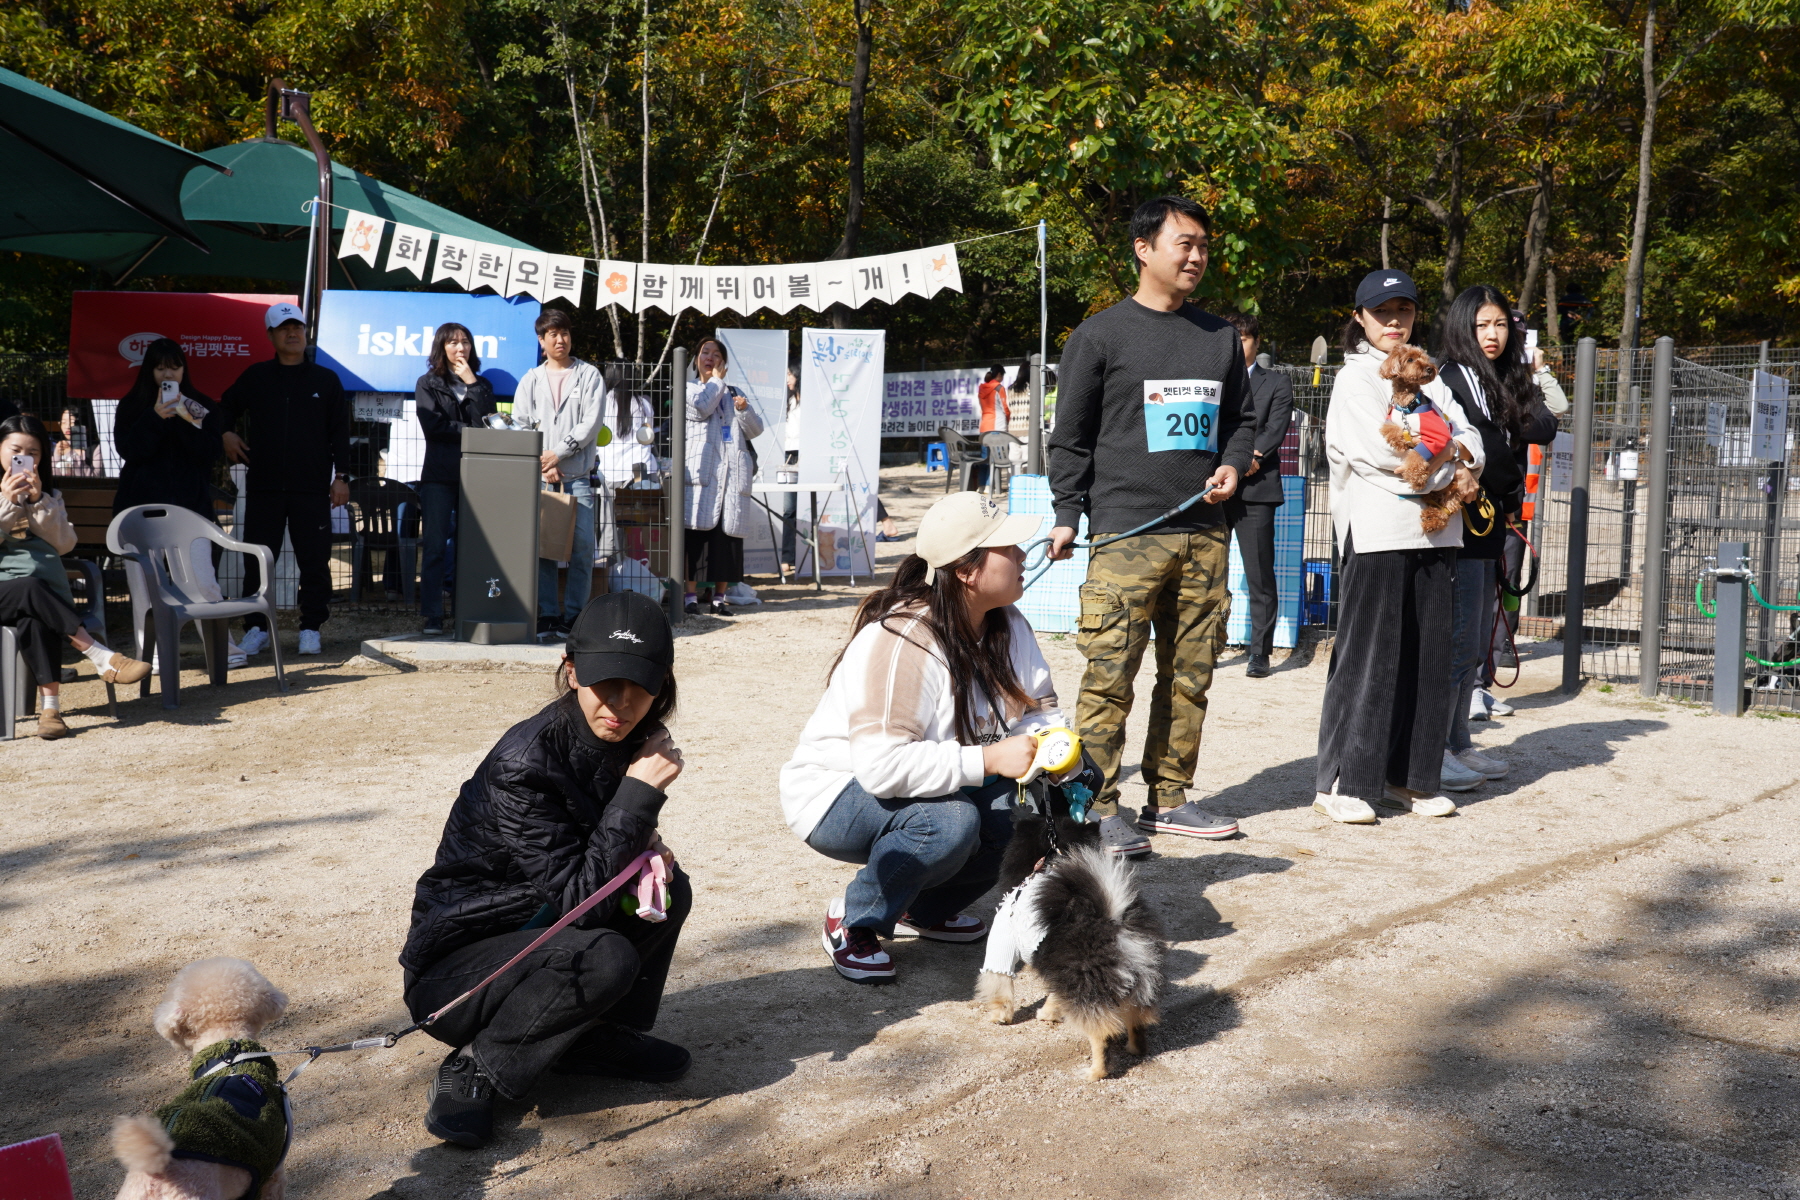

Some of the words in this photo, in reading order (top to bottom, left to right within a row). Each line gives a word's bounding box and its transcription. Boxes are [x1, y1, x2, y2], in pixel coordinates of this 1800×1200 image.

[180, 342, 251, 357] 하림펫푸드
[887, 379, 926, 398] 반려견
[930, 377, 970, 397] 놀이터
[1193, 386, 1217, 397] 운동회
[376, 397, 384, 407] 및
[931, 398, 973, 417] 않도록
[357, 407, 374, 417] 조심
[376, 407, 401, 417] 하세요
[908, 420, 935, 433] 놀이터
[1165, 412, 1211, 438] 209
